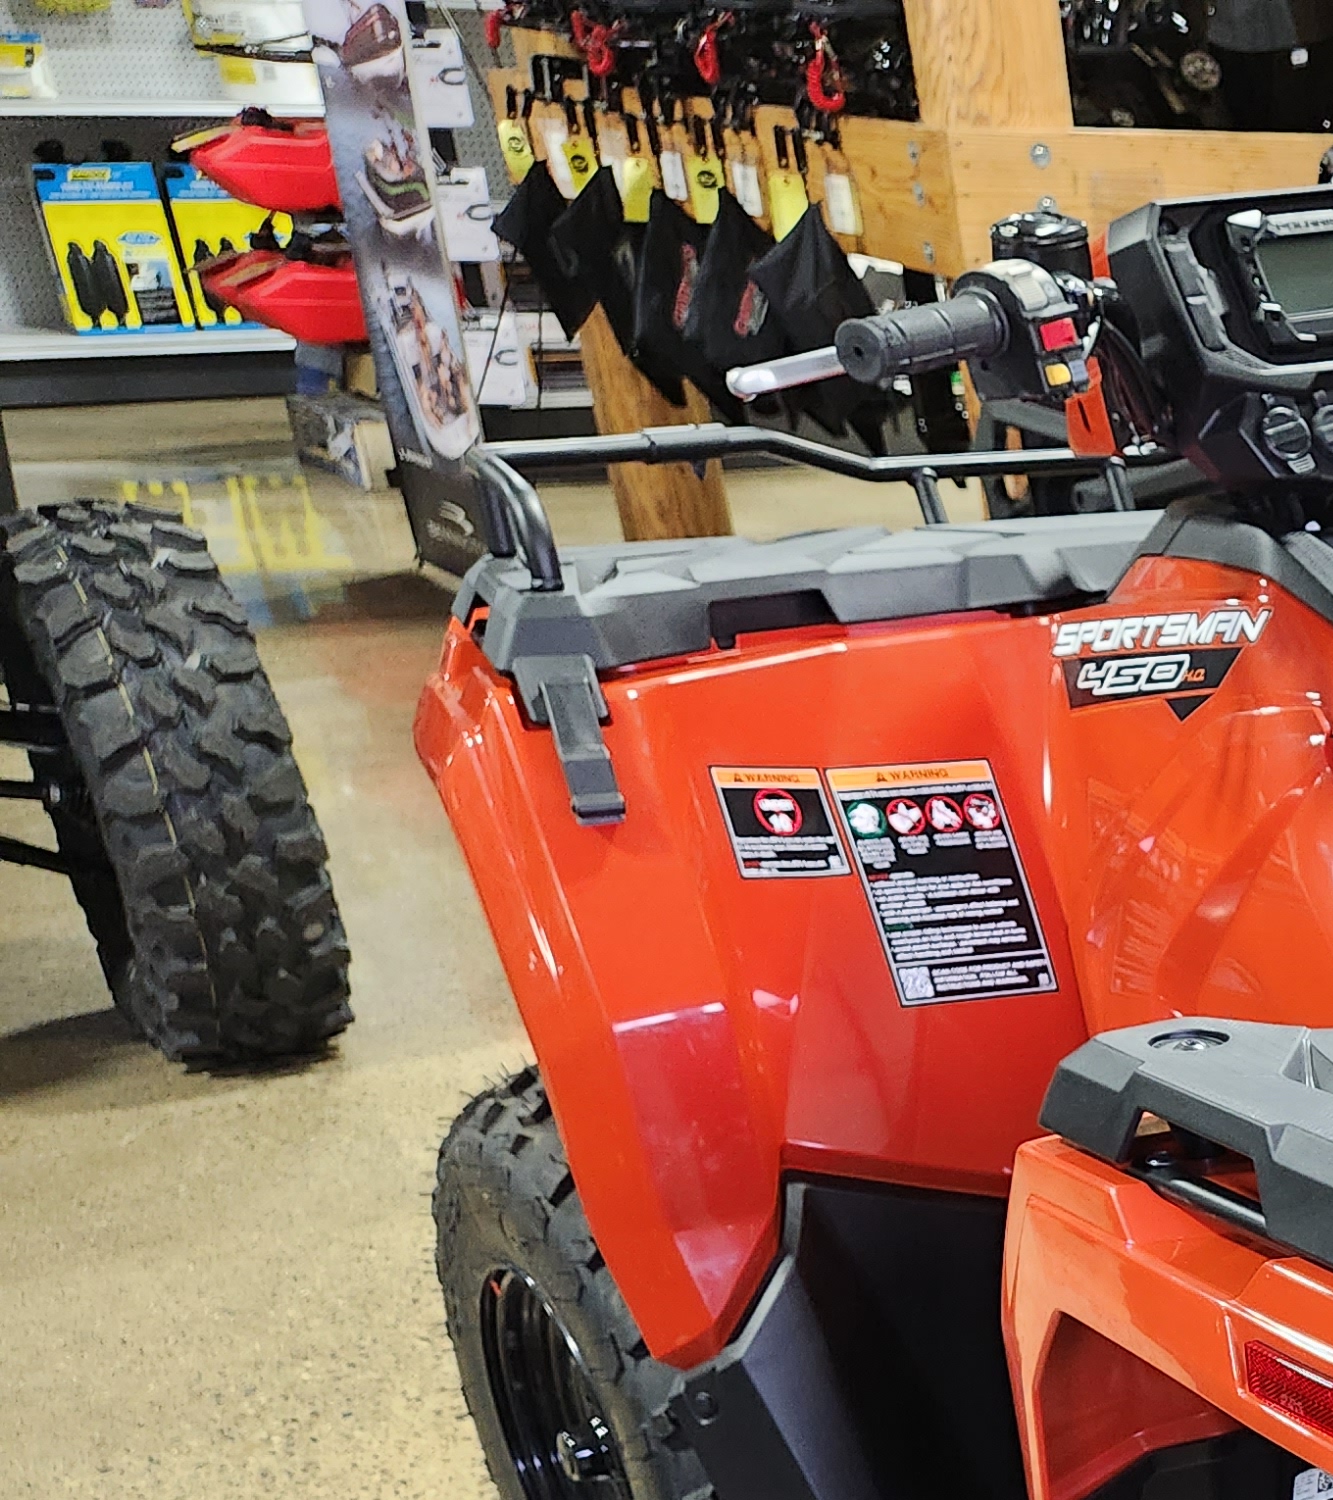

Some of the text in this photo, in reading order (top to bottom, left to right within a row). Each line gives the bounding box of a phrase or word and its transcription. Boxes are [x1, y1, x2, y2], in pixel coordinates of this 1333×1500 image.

[1052, 606, 1273, 658] SPORTSMAN
[1076, 653, 1191, 697] 450
[747, 773, 801, 784] WARNING
[890, 767, 949, 782] WARNING
